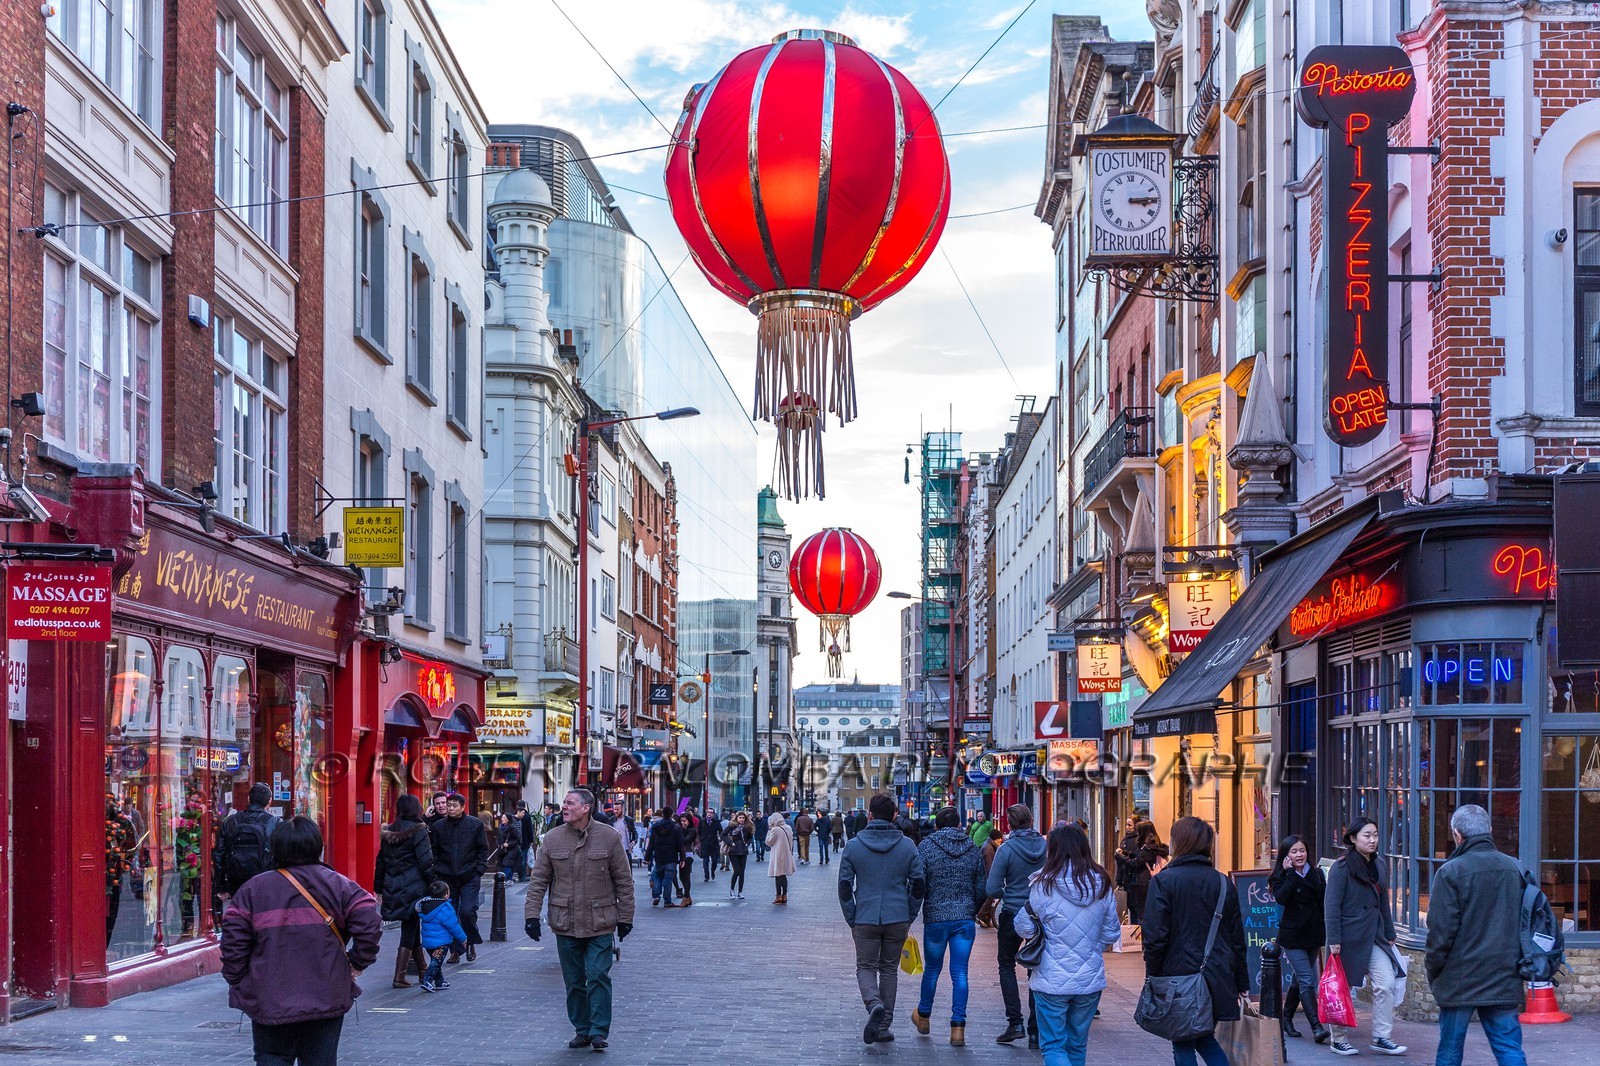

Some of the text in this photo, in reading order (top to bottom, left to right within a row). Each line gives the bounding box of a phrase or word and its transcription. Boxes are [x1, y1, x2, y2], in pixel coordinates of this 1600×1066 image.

[1306, 62, 1413, 96] Astoria
[1095, 152, 1166, 178] COSTUMIER
[1095, 224, 1167, 251] PERRUQUIER
[1346, 113, 1372, 380] PIZZERIA
[1332, 386, 1386, 415] OPEN
[1341, 407, 1388, 432] LATE
[348, 526, 398, 535] VIETNAMESE
[349, 553, 380, 561] 020-7494
[23, 572, 95, 582] Red Lotus Spa
[12, 586, 107, 602] MASSAGE
[156, 550, 315, 631] VIETNAMESE RESTAURANT
[30, 606, 90, 615] 0207 494 4077
[1186, 584, 1215, 627] 旺記
[14, 618, 101, 629] redlotusspa.co.uk
[41, 629, 77, 637] 2nd floor
[1172, 633, 1201, 647] Won
[1090, 647, 1110, 676] 旺記
[1424, 657, 1512, 684] OPEN
[1080, 679, 1121, 691] Wong Kei
[655, 688, 667, 697] 22
[485, 708, 533, 718] ERRARD'S
[486, 719, 526, 728] CORNER
[476, 728, 531, 737] STAURANT
[28, 738, 38, 747] 34
[1051, 741, 1096, 749] MASSAGE
[993, 753, 1018, 764] OPEN
[1003, 764, 1016, 773] HOU
[1251, 906, 1276, 914] RESTA
